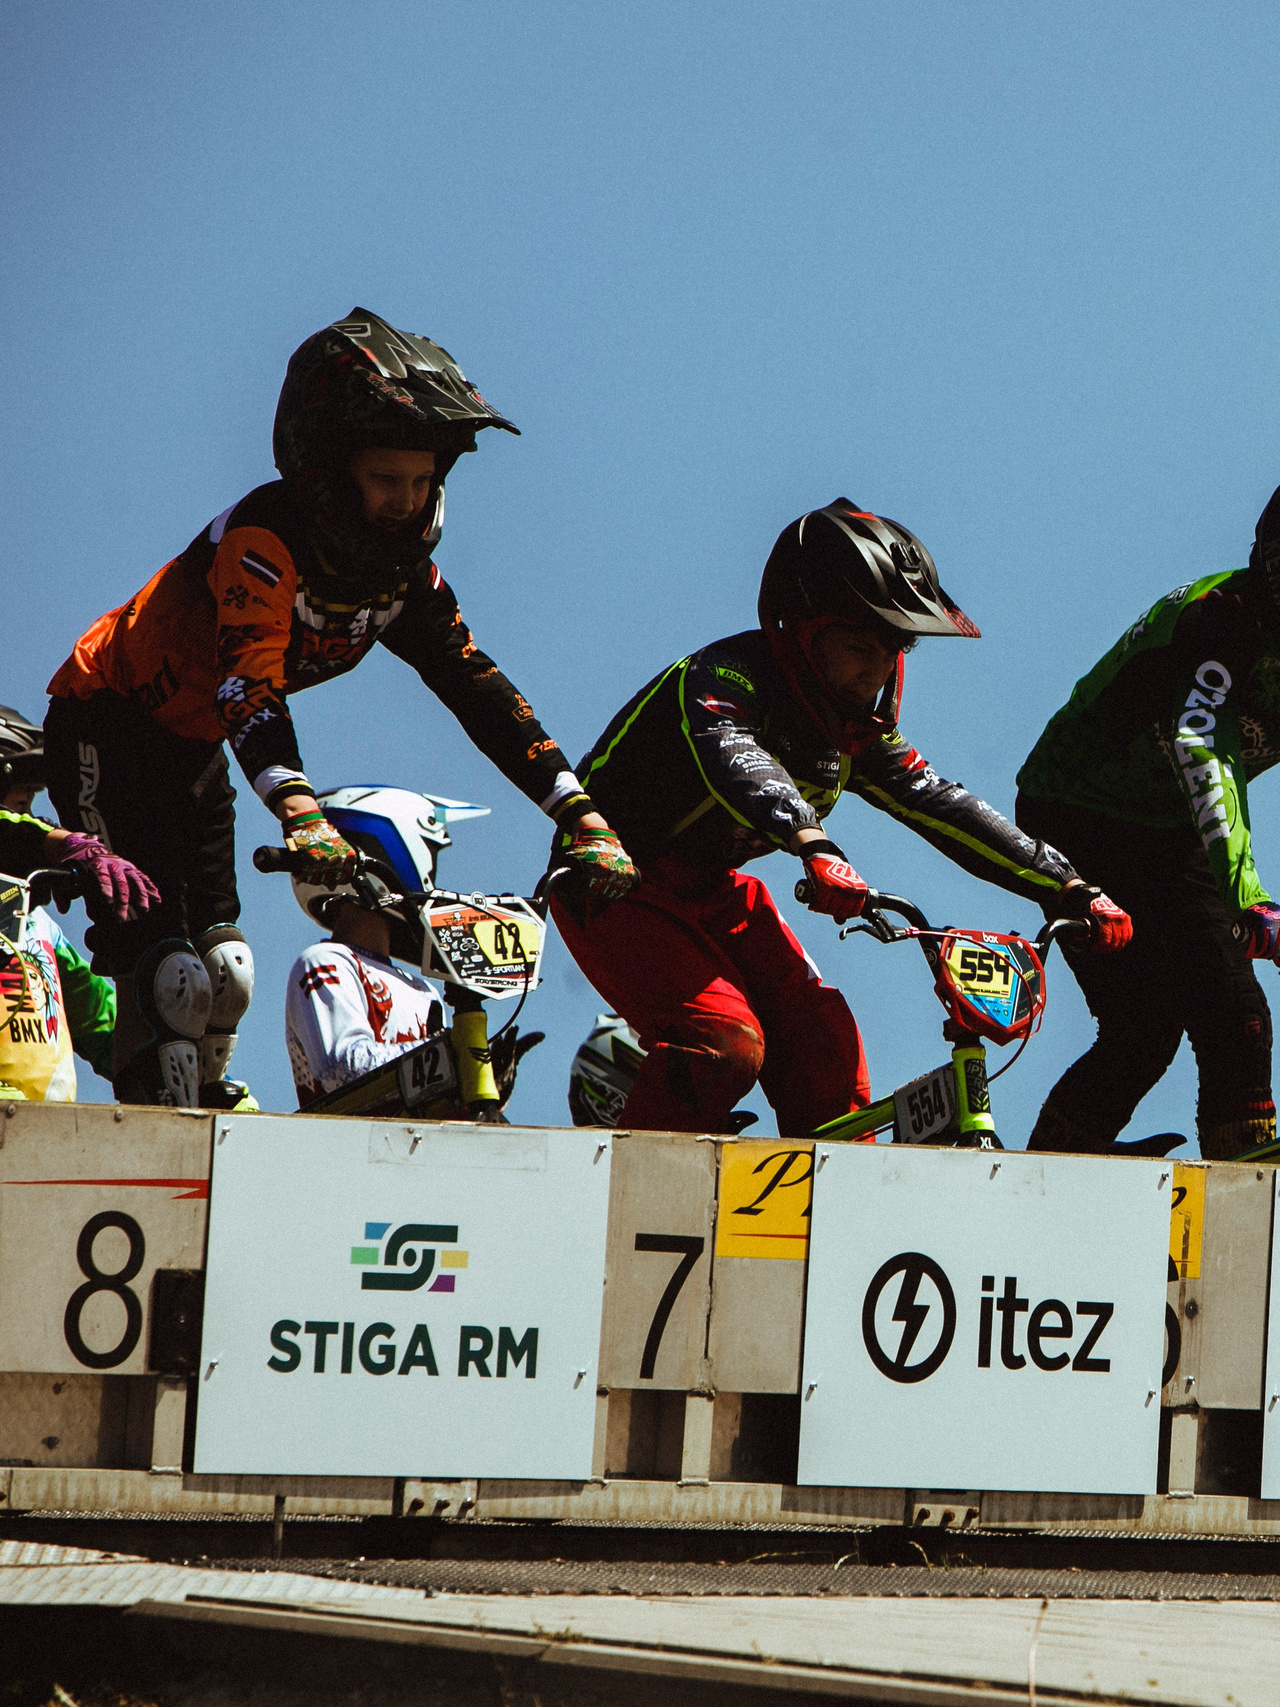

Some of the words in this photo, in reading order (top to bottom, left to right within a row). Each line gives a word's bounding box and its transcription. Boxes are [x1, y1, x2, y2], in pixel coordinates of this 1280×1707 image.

[494, 922, 524, 960] 42
[982, 931, 999, 944] box
[959, 949, 1010, 986] 554
[10, 1018, 47, 1044] BMX
[412, 1046, 445, 1089] 42
[907, 1078, 946, 1135] 554
[64, 1211, 146, 1369] 8
[634, 1233, 705, 1379] 7
[267, 1319, 439, 1376] STIGA
[458, 1325, 539, 1379] RM
[977, 1275, 1115, 1373] itez
